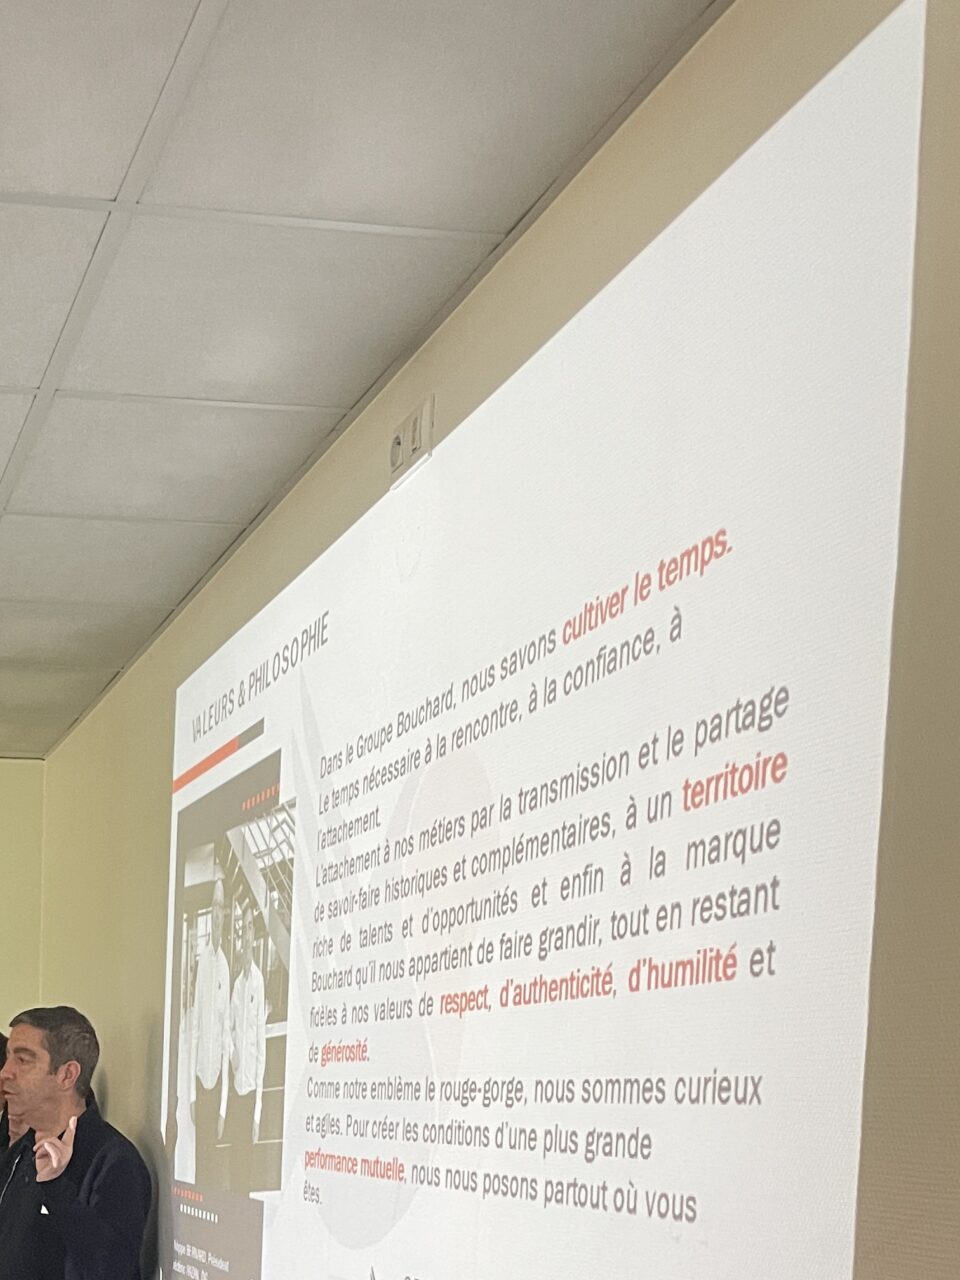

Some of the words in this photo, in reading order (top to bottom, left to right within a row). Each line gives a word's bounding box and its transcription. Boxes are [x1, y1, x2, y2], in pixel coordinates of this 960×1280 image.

[192, 688, 235, 743] VALEURS
[238, 680, 246, 708] &
[248, 610, 329, 701] PHILOSOPHIE
[319, 793, 329, 816] Le
[332, 779, 360, 809] temps
[362, 749, 421, 795] nécessaire
[424, 737, 432, 764] à
[436, 733, 446, 760] la
[451, 699, 522, 752] rencontre,
[528, 682, 538, 714] à
[543, 676, 557, 708] la
[563, 626, 661, 696] confiance,
[669, 605, 682, 642] à
[320, 751, 342, 779] Dans
[345, 742, 354, 765] le
[356, 722, 393, 759] Groupe
[396, 682, 456, 738] Bouchard,
[462, 664, 495, 702] nous
[500, 628, 556, 680] savons
[562, 585, 629, 645] cultiver
[634, 571, 652, 606] le
[657, 528, 733, 592] temps.
[384, 838, 390, 864] à
[394, 835, 414, 861] nos
[419, 815, 465, 852] métiers
[470, 803, 494, 838] par
[499, 793, 512, 823] la
[519, 749, 629, 816] transmission
[638, 731, 659, 770] et
[666, 725, 684, 761] le
[694, 685, 789, 757] partage
[313, 935, 333, 959] riche
[340, 929, 351, 953] de
[359, 920, 393, 949] talents
[402, 913, 413, 939] et
[421, 885, 518, 936] d'opportunités
[531, 876, 547, 908] et
[560, 863, 604, 901] enfin
[620, 851, 631, 886] à
[649, 845, 666, 880] la
[685, 817, 781, 871] marque
[314, 901, 325, 924] de
[327, 885, 380, 920] savoir-faire
[384, 865, 448, 902] historiques
[453, 856, 467, 883] et
[471, 810, 616, 878] complémentaires,
[625, 795, 637, 831] à
[647, 790, 672, 824] un
[682, 750, 789, 813] territoire
[310, 1005, 337, 1028] fidèles
[341, 1001, 347, 1025] à
[351, 1003, 369, 1024] nos
[374, 997, 413, 1022] valeurs
[419, 991, 433, 1017] de
[440, 984, 492, 1019] respect,
[499, 961, 617, 1007] d'authenticité,
[628, 941, 738, 993] d'humilité
[749, 939, 776, 977] et
[311, 965, 352, 993] Bouchard
[355, 960, 376, 990] qu'il
[379, 957, 405, 982] nous
[408, 943, 473, 981] appartient
[476, 937, 494, 965] de
[499, 929, 533, 961] faire
[538, 913, 602, 961] grandir,
[610, 903, 649, 941] tout
[655, 900, 682, 933] en
[691, 875, 780, 926] restant
[307, 1077, 340, 1099] Comme
[343, 1078, 367, 1100] notre
[370, 1075, 421, 1101] emblème
[425, 1076, 435, 1101] le
[440, 1076, 527, 1108] rouge-gorge,
[534, 1078, 575, 1103] nous
[581, 1076, 666, 1105] sommes
[674, 1067, 763, 1106] curieux
[309, 1040, 319, 1063] de
[320, 1037, 370, 1068] générosité.
[303, 1180, 322, 1205] êtes.
[304, 1147, 358, 1174] performance
[360, 1156, 407, 1184] mutuelle,
[411, 1164, 440, 1188] nous
[445, 1167, 478, 1193] nous
[482, 1172, 538, 1201] posons
[544, 1177, 608, 1212] partout
[613, 1179, 637, 1215] où
[645, 1191, 697, 1223] vous
[305, 1114, 314, 1133] et
[315, 1113, 343, 1139] agiles.
[346, 1114, 369, 1138] Pour
[371, 1115, 399, 1141] créer
[402, 1117, 418, 1142] les
[422, 1119, 490, 1148] conditions
[495, 1121, 537, 1151] d'une
[542, 1123, 578, 1159] plus
[584, 1126, 652, 1164] grande
